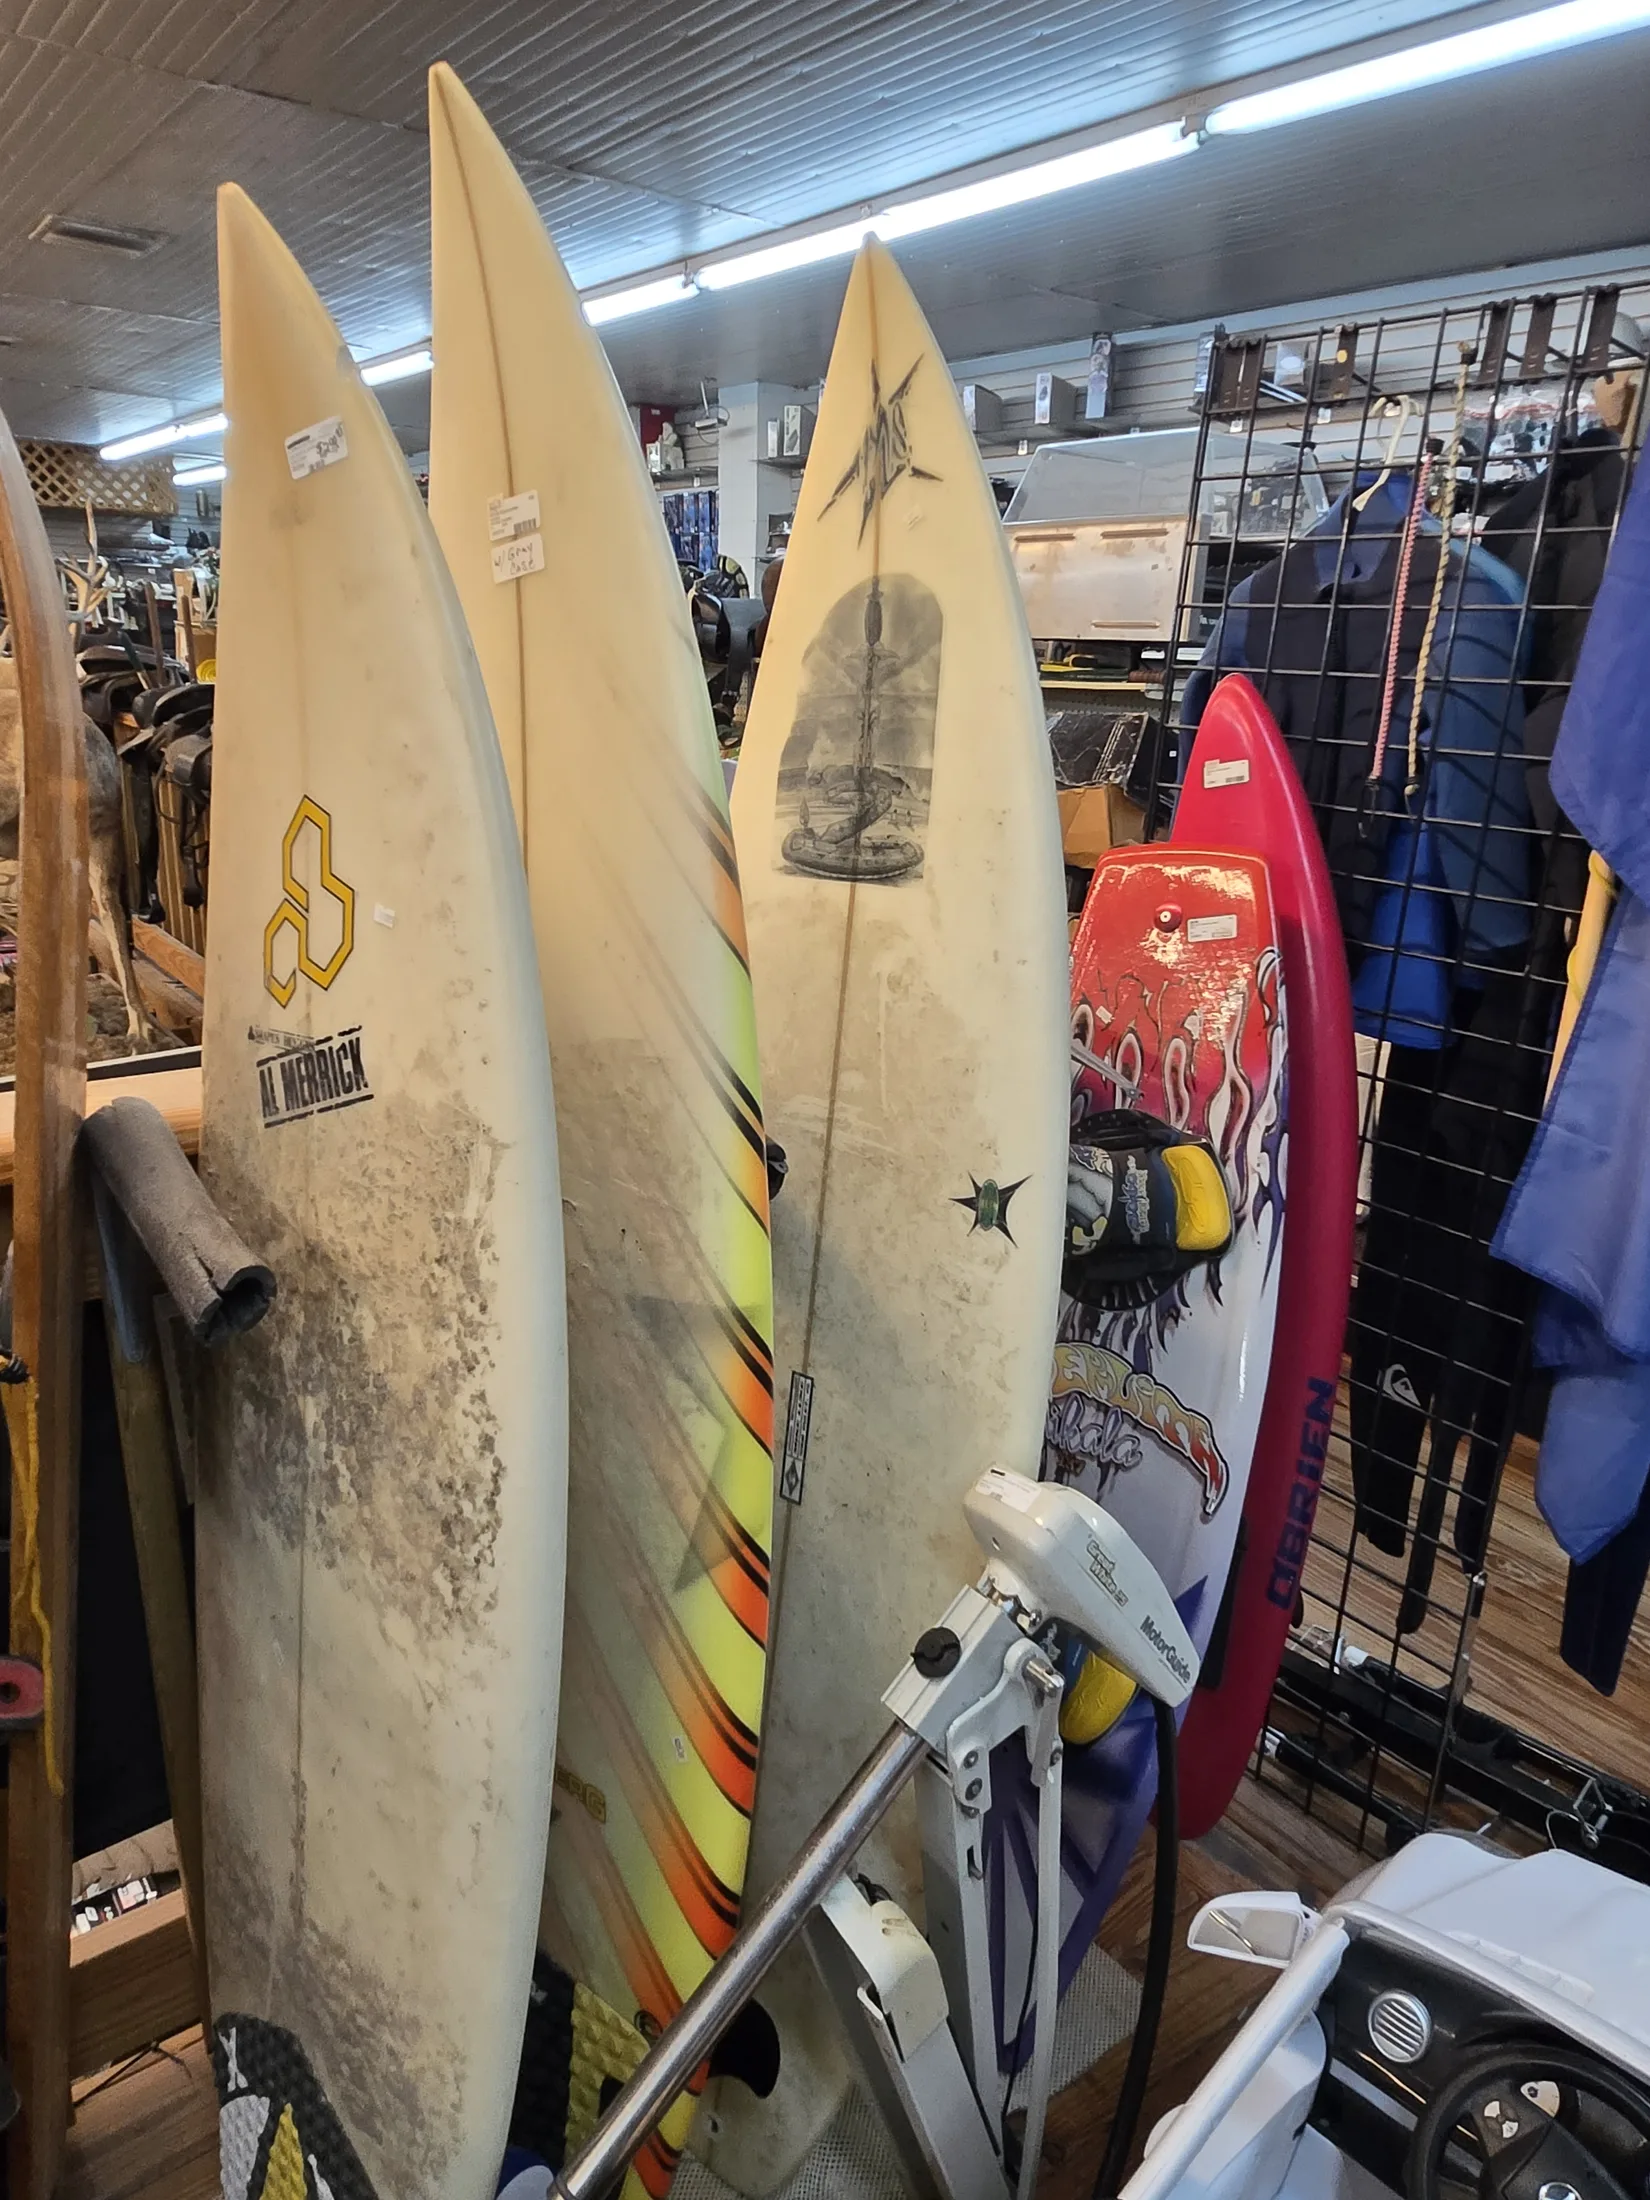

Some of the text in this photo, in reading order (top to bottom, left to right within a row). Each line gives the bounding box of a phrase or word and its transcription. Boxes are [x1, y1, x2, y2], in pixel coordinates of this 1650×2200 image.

[259, 1036, 369, 1119] AL MERRICK
[1139, 1614, 1192, 1684] MotorGuide
